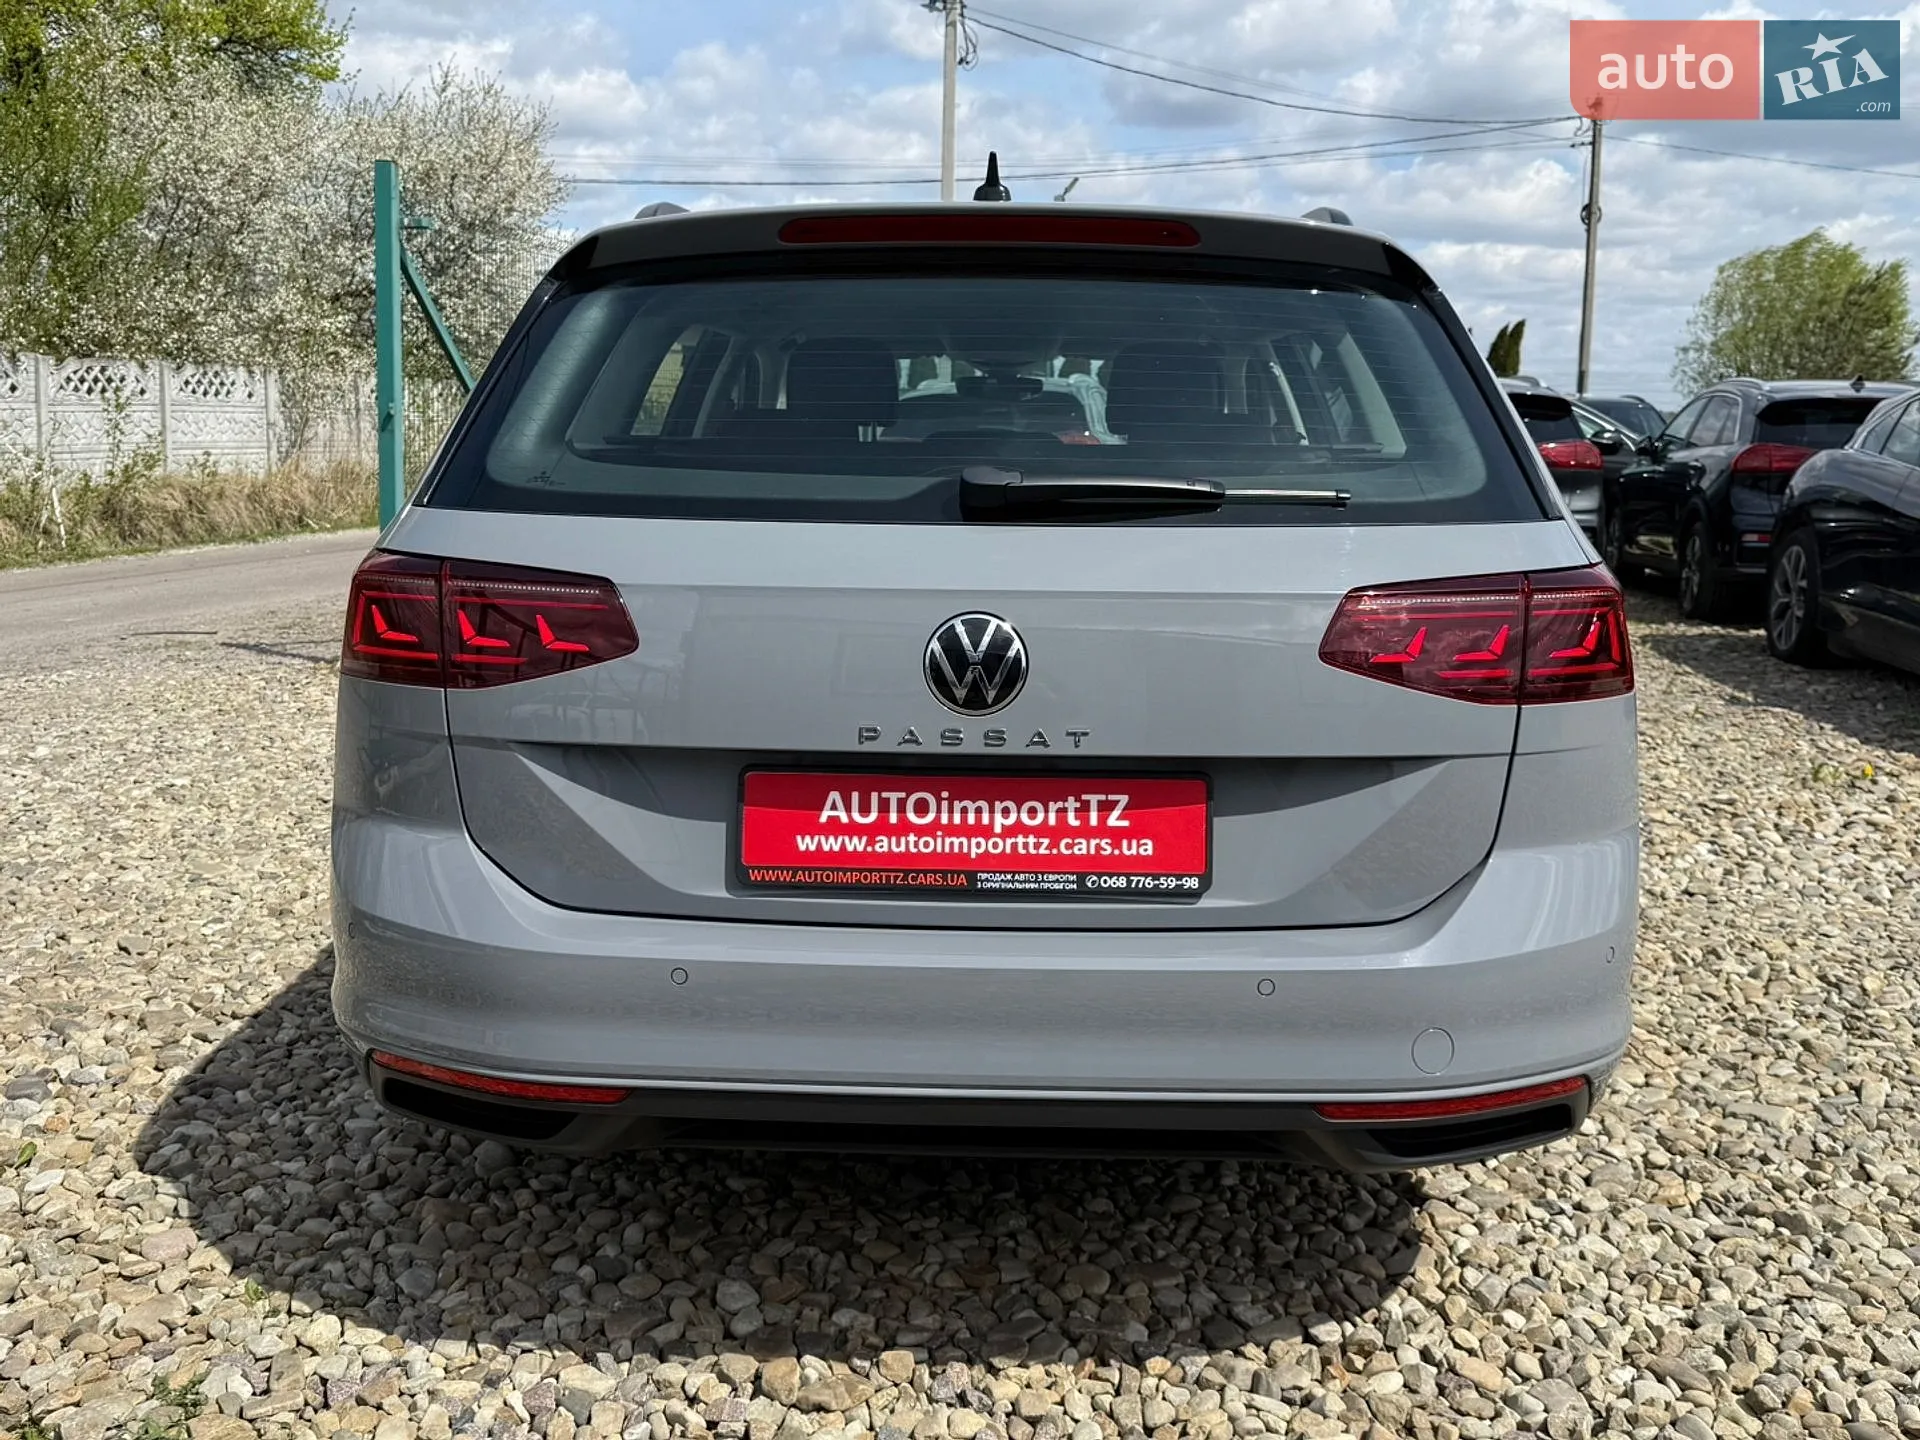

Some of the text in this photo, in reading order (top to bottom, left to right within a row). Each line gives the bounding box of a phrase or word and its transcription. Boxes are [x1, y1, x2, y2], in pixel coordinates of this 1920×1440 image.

[858, 726, 1091, 748] PASSAT
[818, 790, 1130, 832] AUTOimportTZ
[796, 831, 1154, 857] www.autoimporttz.cars.ua
[749, 869, 968, 887] WWW.AUTOIMPORTTZ.CARS.UA
[977, 873, 1013, 882] ПРОДАЖ
[1014, 873, 1036, 881] АВТО
[1100, 876, 1199, 889] 068 776-59-98
